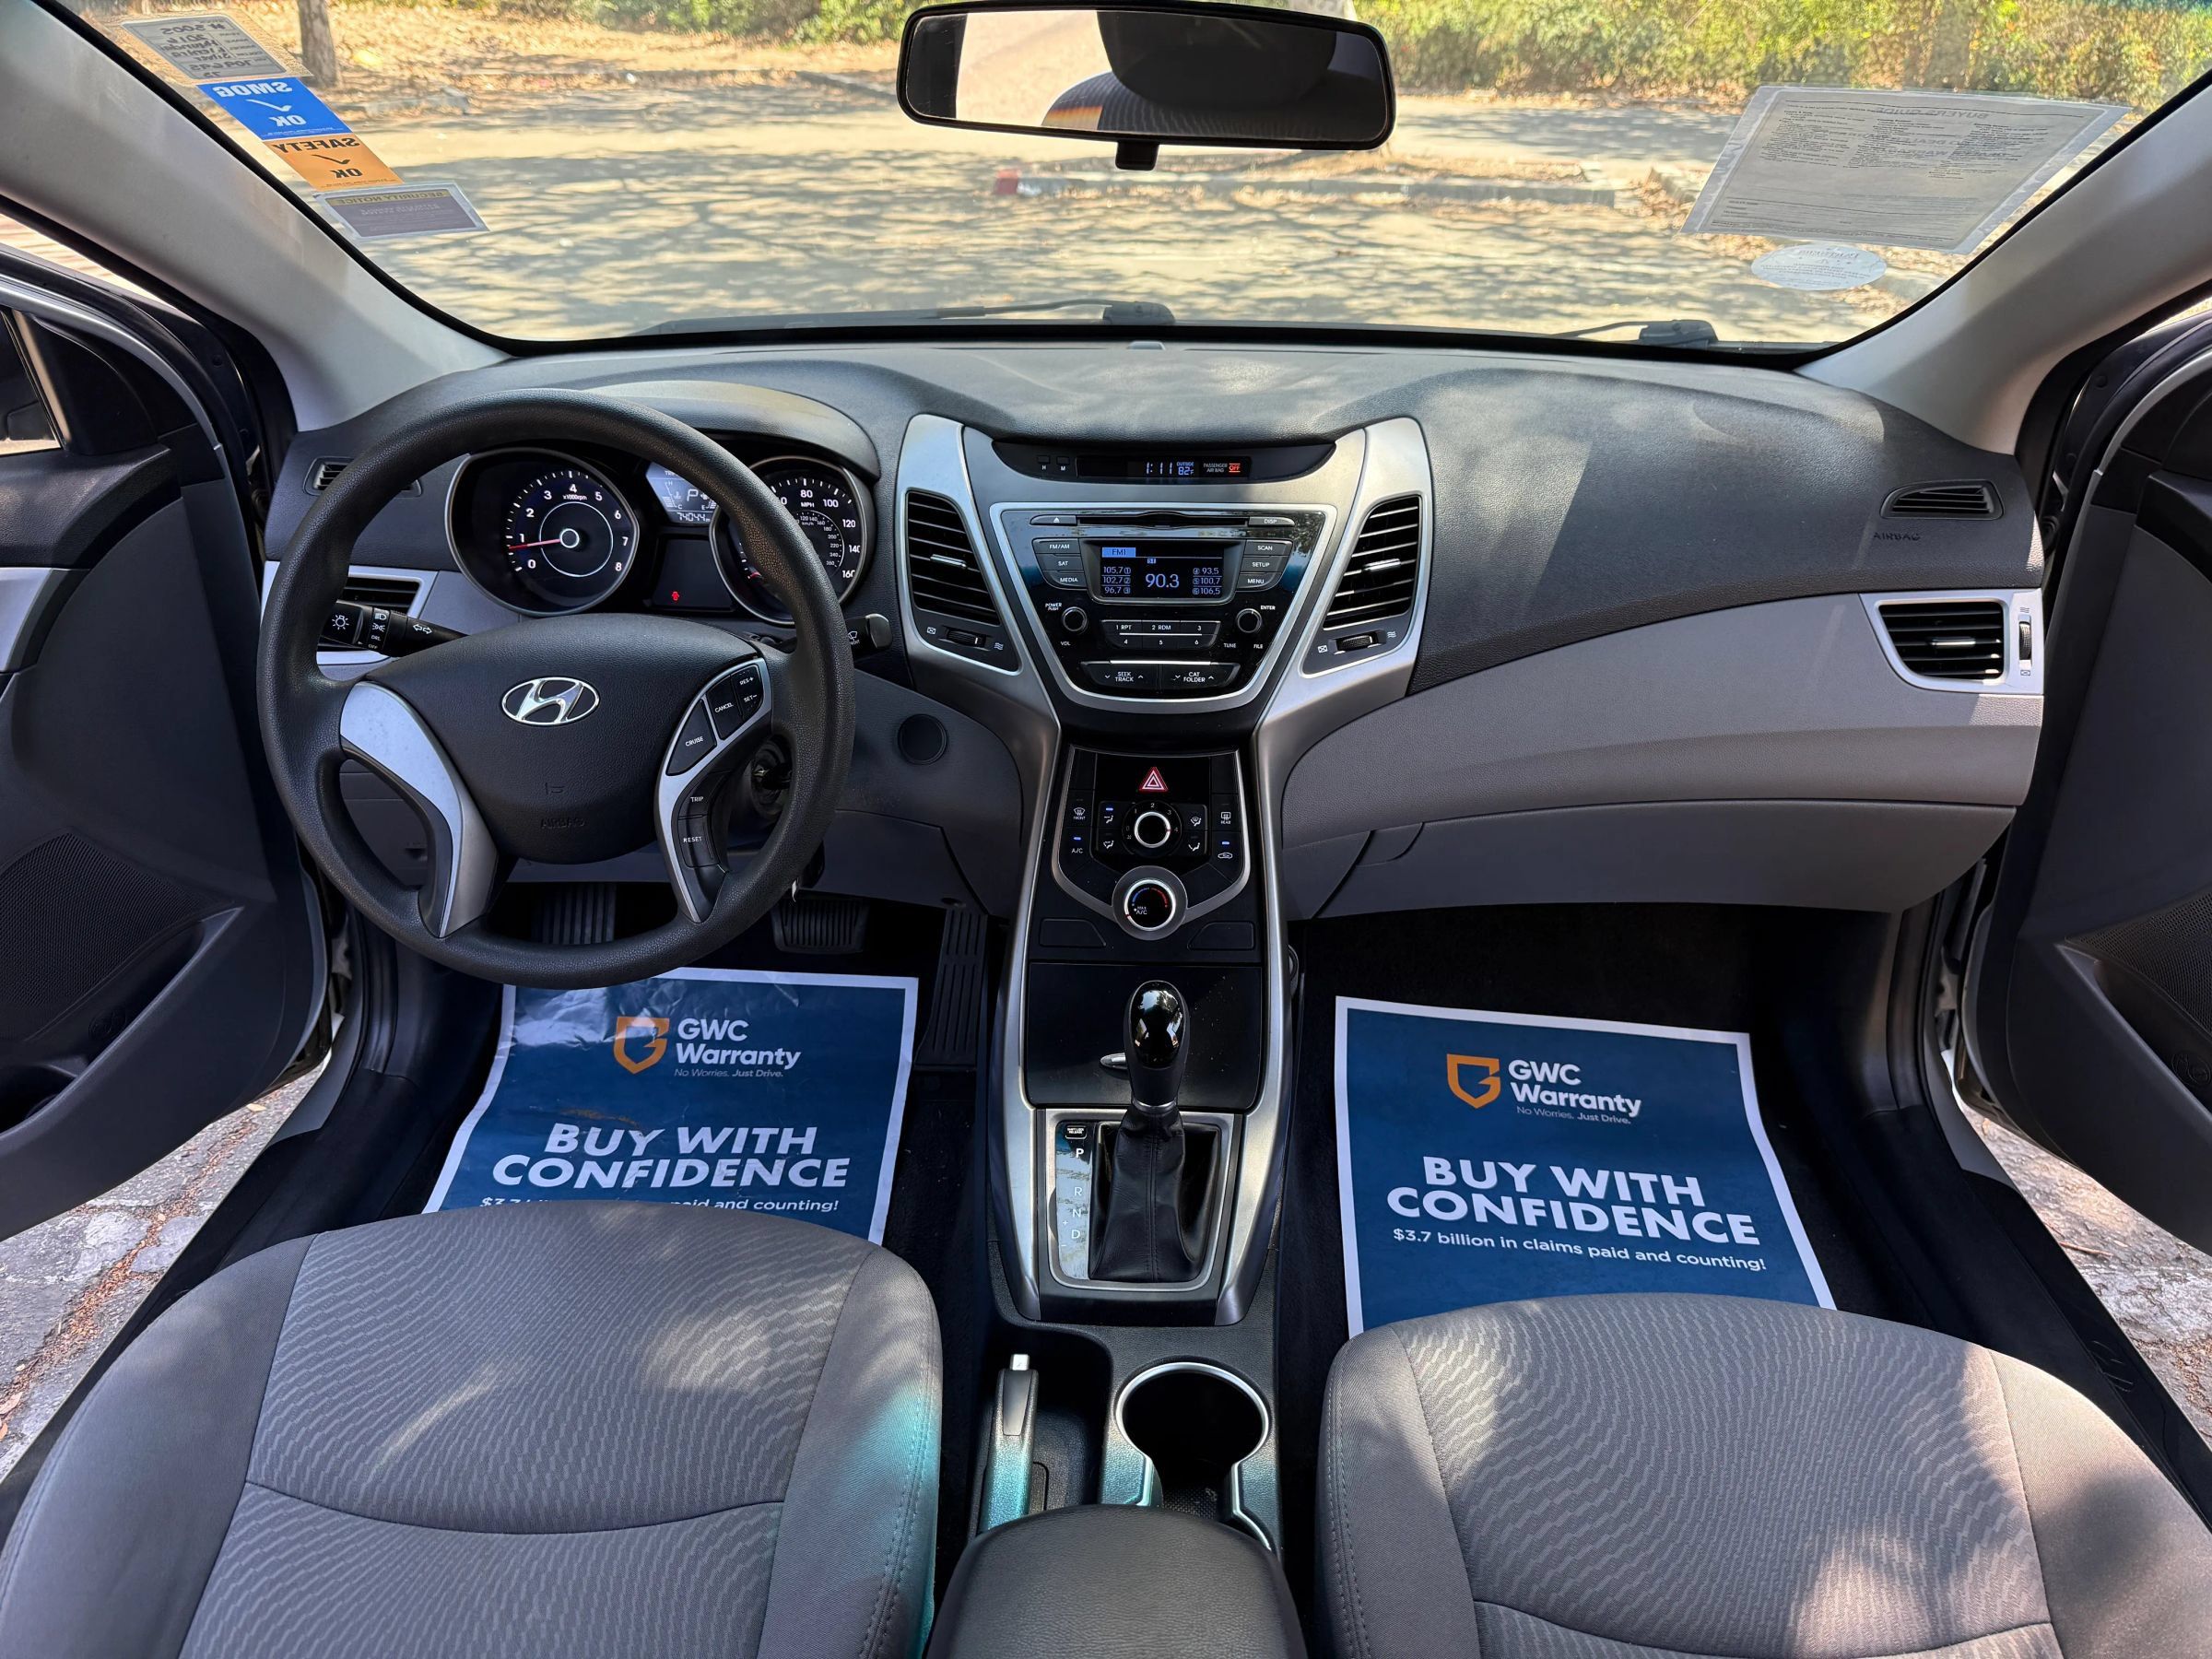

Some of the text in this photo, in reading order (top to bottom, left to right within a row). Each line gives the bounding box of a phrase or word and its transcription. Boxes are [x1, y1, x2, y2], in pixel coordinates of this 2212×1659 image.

[1146, 462, 1173, 475] 1:11
[569, 484, 577, 492] 4
[544, 490, 552, 500] 3
[594, 491, 603, 500] 5
[687, 488, 699, 502] P
[800, 489, 813, 498] 80
[822, 499, 839, 508] 100
[526, 509, 535, 518] 2
[615, 511, 621, 520] 6
[677, 512, 706, 522] 74044
[842, 519, 856, 528] 120
[519, 534, 524, 542] 1
[622, 536, 629, 546] 7
[1873, 532, 1921, 541] AIRBAG
[528, 559, 536, 569] 0
[615, 562, 622, 571] 8
[1103, 566, 1124, 574] 105.7
[1202, 567, 1219, 575] 93.5
[1103, 576, 1124, 584] 102.7
[1145, 573, 1180, 588] 90.3
[1200, 577, 1220, 585] 100.7
[1104, 586, 1122, 594] 96.7
[1200, 587, 1220, 595] 106.5
[714, 701, 735, 712] CANCEL
[685, 736, 704, 747] CRUISE
[540, 818, 588, 830] AIRBAG
[677, 1018, 749, 1041] GWC
[677, 1042, 802, 1070] Warranty
[674, 1068, 783, 1077] No Worries. Just Drive.
[1508, 1059, 1583, 1086] GWC
[1510, 1082, 1642, 1118] Warranty
[1516, 1106, 1631, 1124] No Worries. Just Drive.
[544, 1123, 818, 1157] BUY WITH
[1076, 1148, 1084, 1159] P
[491, 1154, 850, 1189] CONFIDENCE
[1423, 1156, 1706, 1207] BUY WITH
[1074, 1186, 1083, 1196] R
[753, 1200, 839, 1213] counting!
[1072, 1209, 1081, 1218] N
[1386, 1186, 1761, 1245] CONFIDENCE
[1071, 1230, 1080, 1239] D
[1393, 1228, 1768, 1272] $3.7 billion in claims paid and counting!
